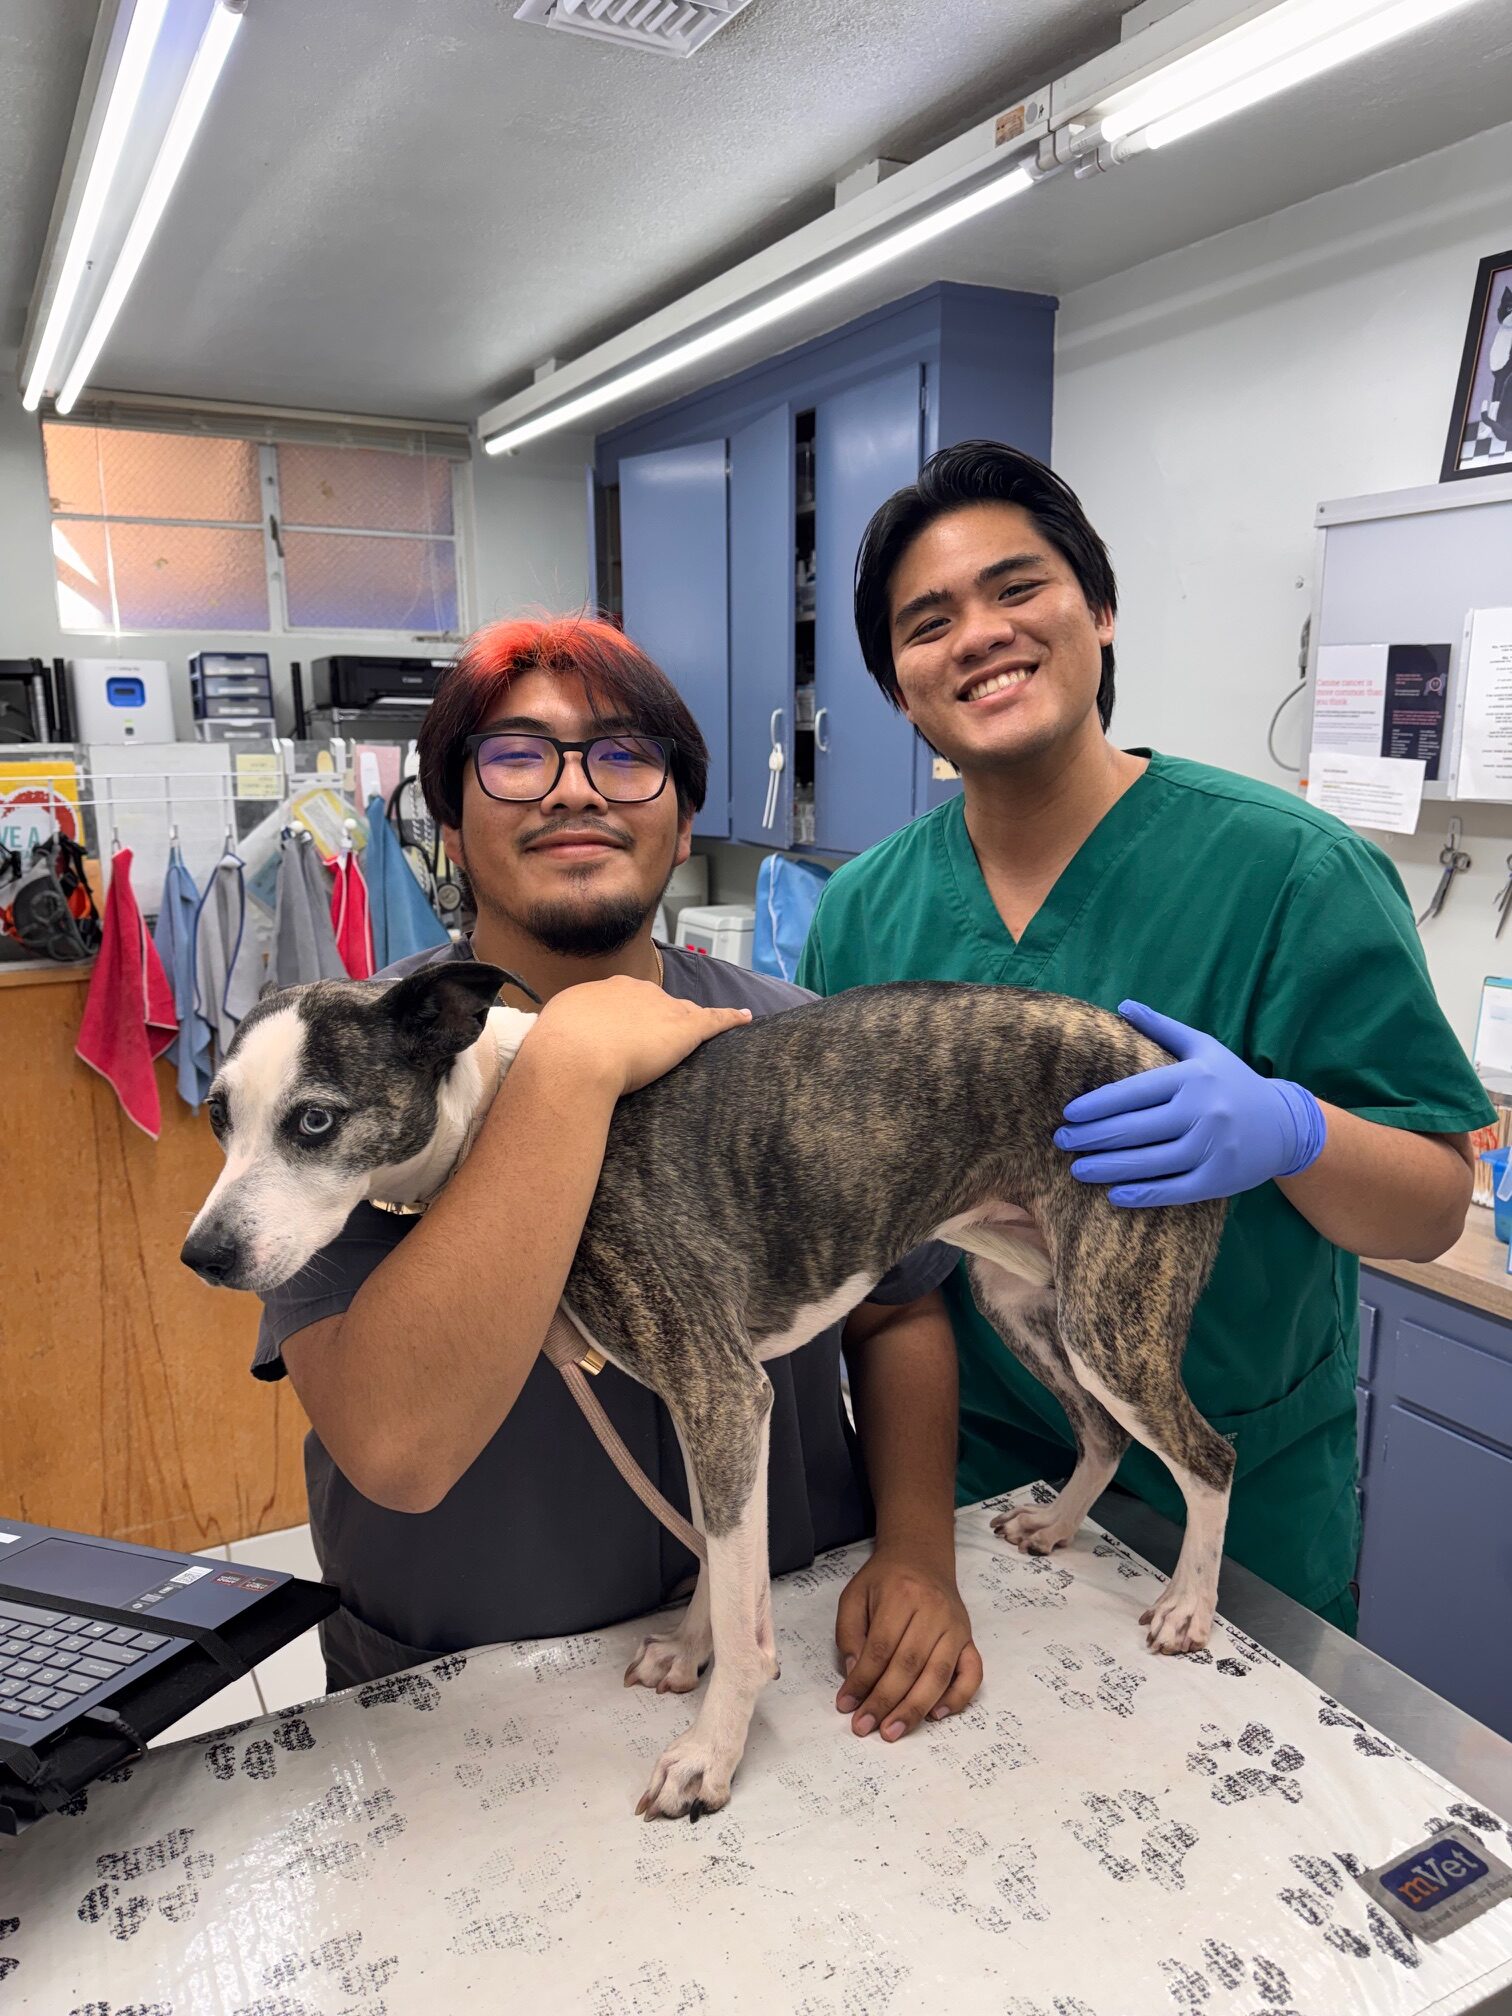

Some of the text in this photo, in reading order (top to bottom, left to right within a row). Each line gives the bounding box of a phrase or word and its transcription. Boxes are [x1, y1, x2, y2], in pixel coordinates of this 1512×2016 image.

[1335, 689, 1365, 697] common
[1367, 689, 1383, 697] than
[1329, 698, 1348, 706] think
[1397, 1848, 1479, 1904] mVet
